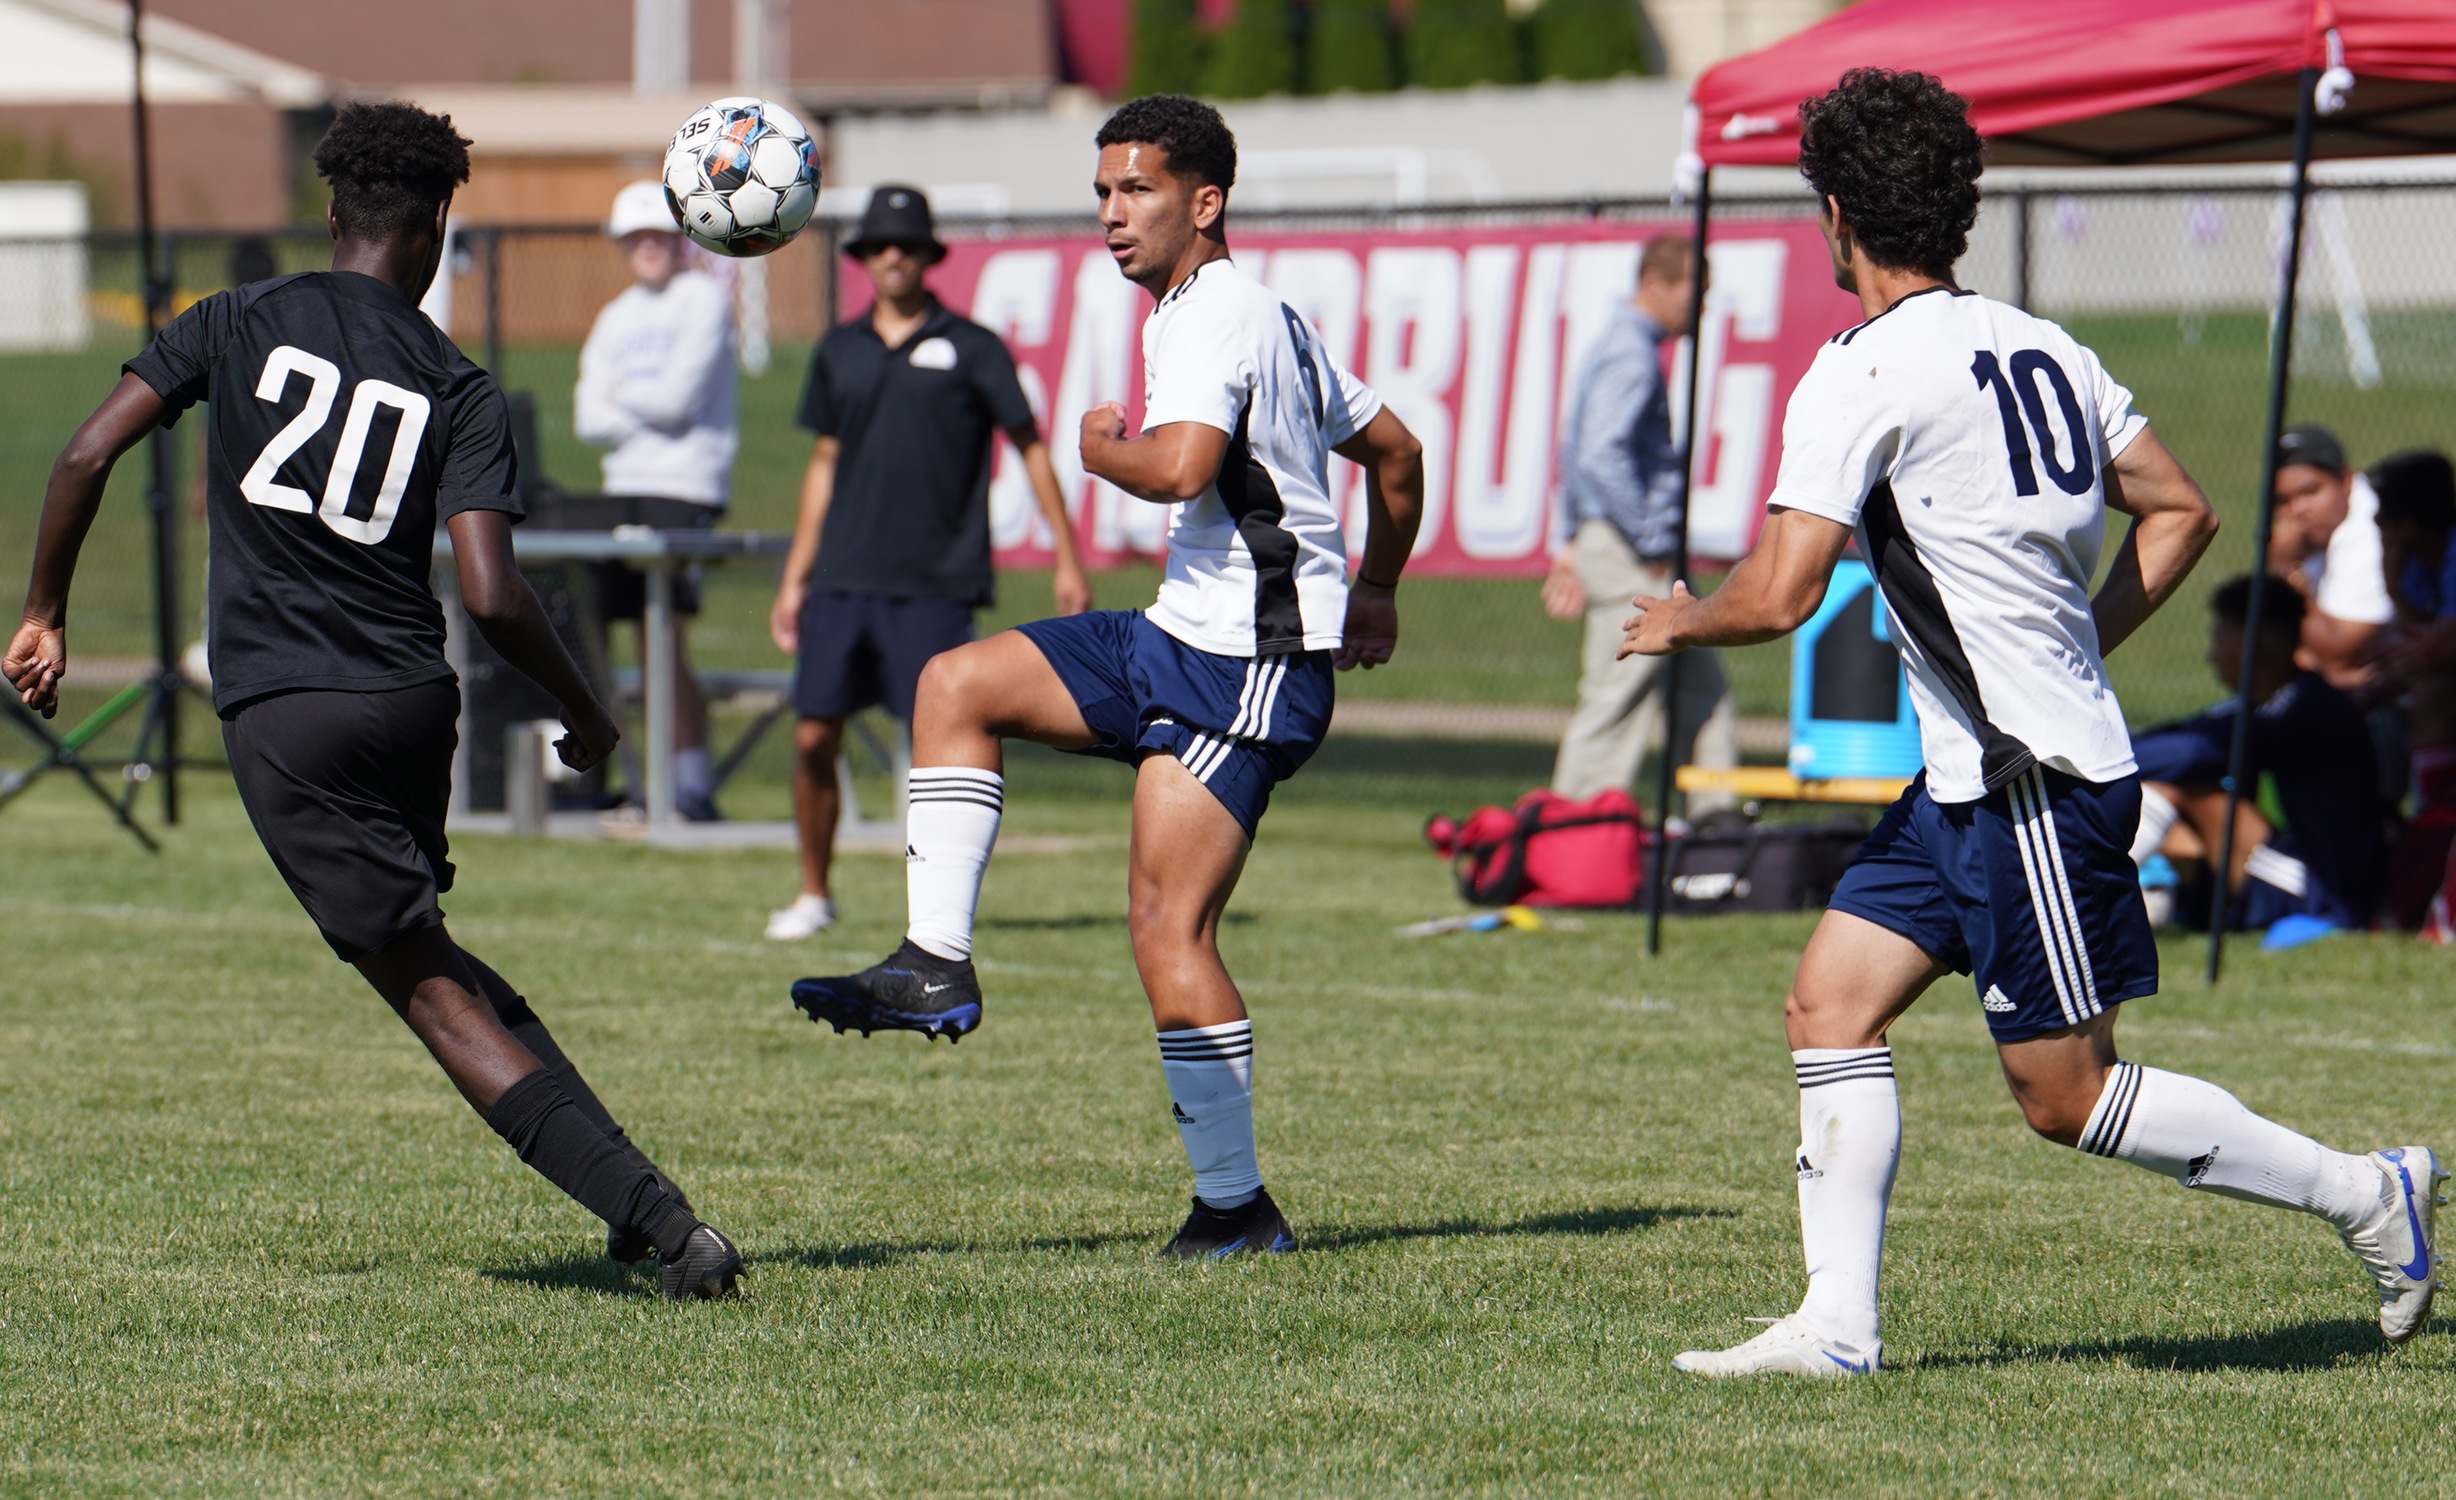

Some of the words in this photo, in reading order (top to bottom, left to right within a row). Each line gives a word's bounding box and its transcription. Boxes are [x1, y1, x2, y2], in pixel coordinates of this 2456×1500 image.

[239, 345, 431, 545] 20
[967, 238, 1788, 559] SABUG
[1970, 349, 2095, 496] 10
